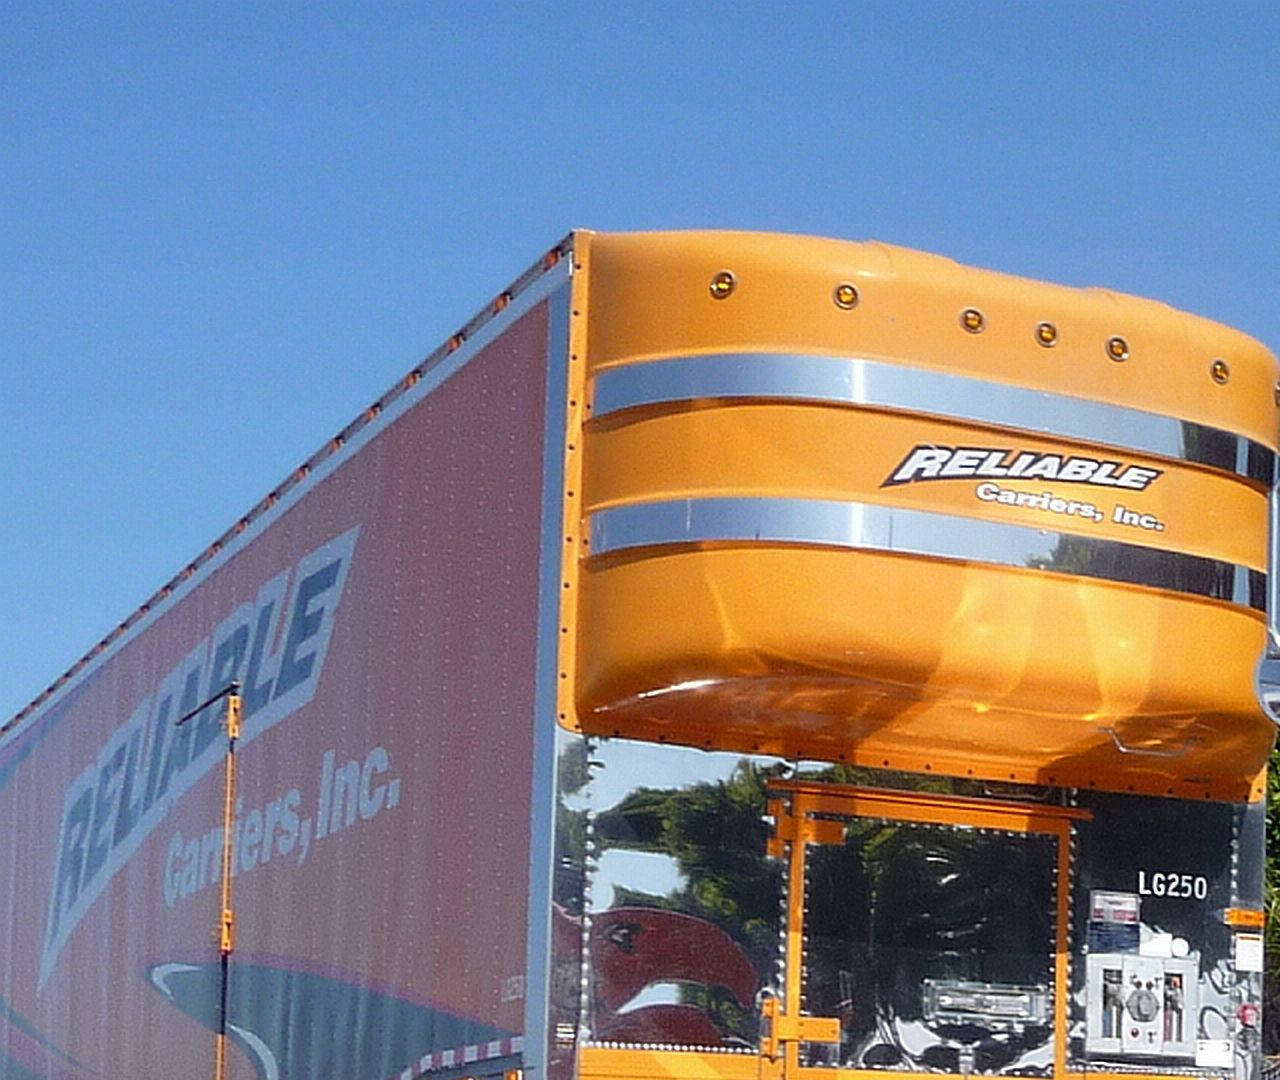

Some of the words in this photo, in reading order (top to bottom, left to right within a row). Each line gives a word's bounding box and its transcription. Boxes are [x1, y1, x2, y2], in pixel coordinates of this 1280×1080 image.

[886, 446, 1160, 490] RELIABLE
[975, 482, 1103, 522] Carriers,
[1112, 506, 1164, 530] Inc.
[44, 552, 346, 968] RELIABLE
[163, 788, 313, 908] Carriers,
[316, 746, 401, 840] Inc.
[1138, 871, 1207, 899] LG250
